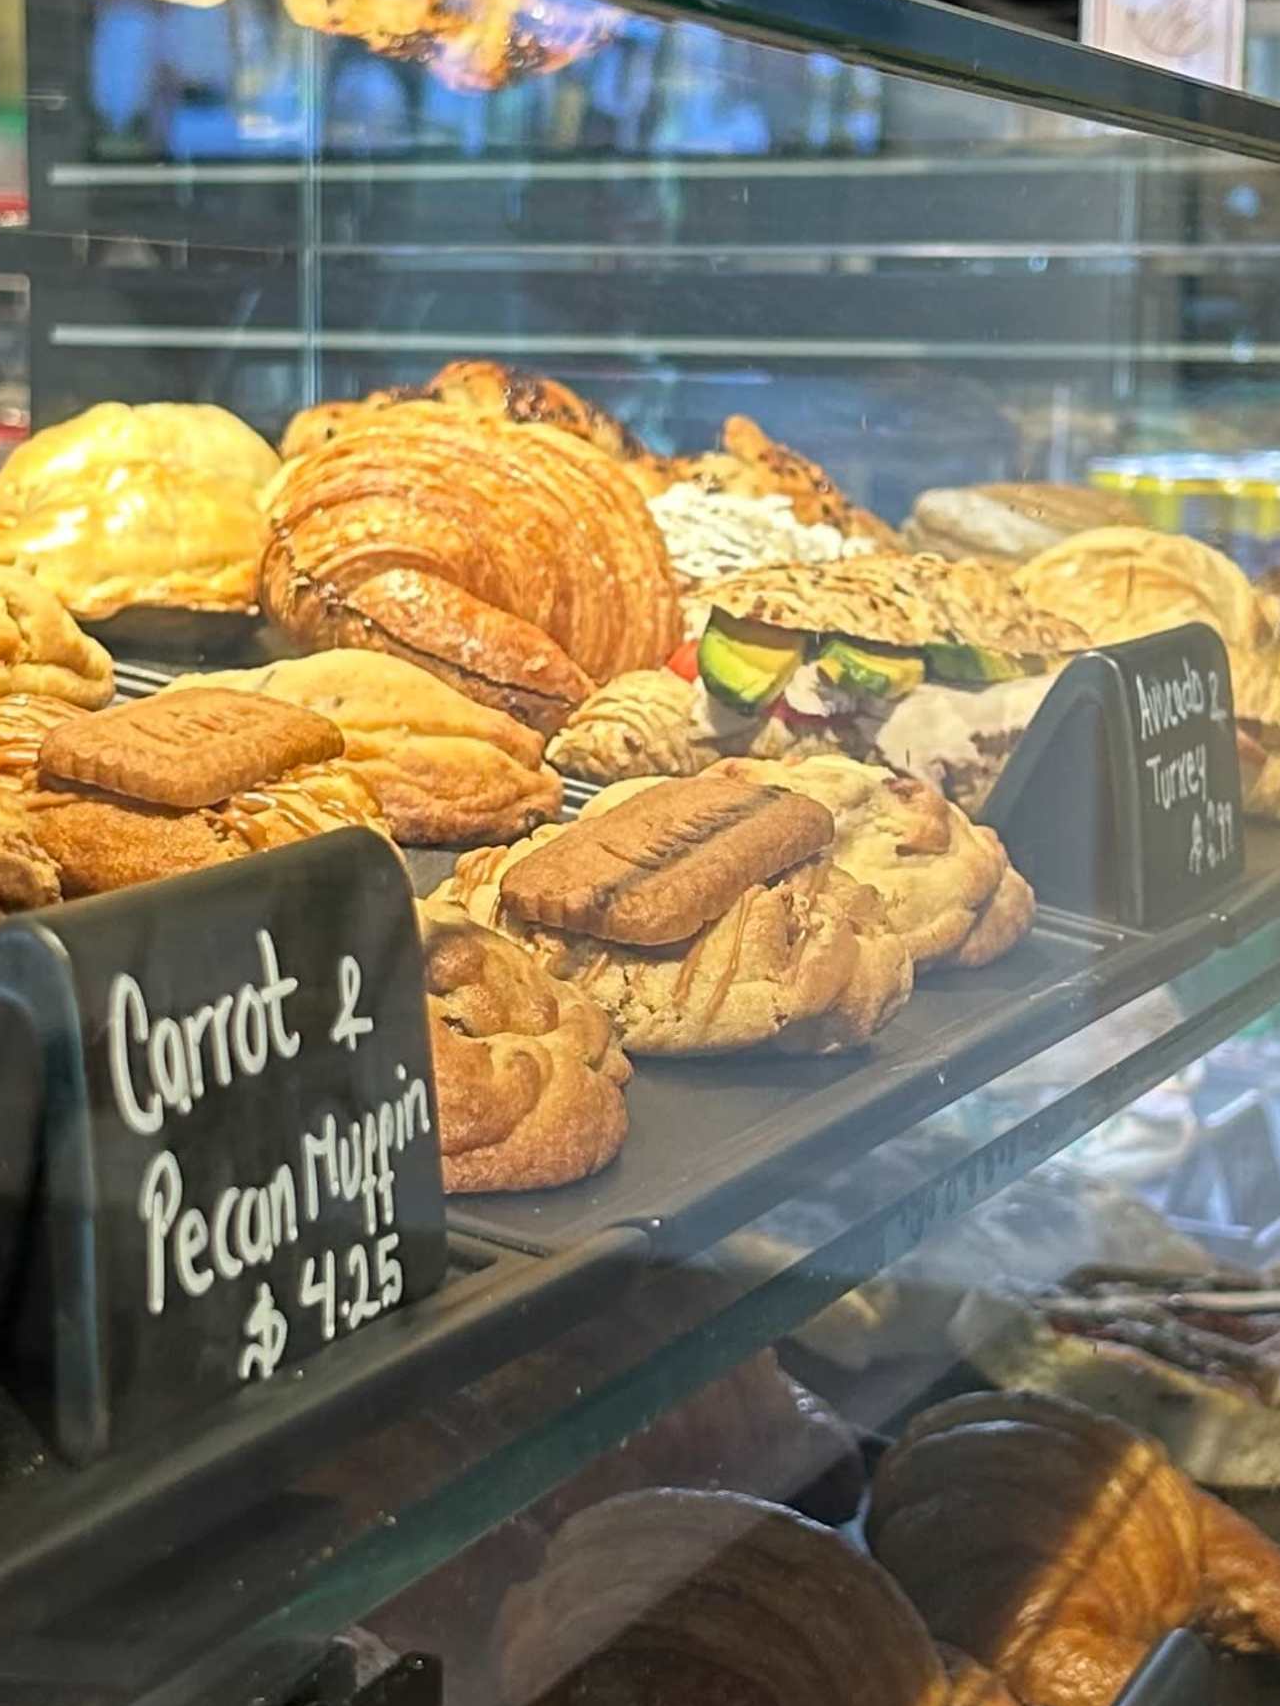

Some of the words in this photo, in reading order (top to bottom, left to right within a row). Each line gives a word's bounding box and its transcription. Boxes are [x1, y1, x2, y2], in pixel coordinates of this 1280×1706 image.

[1145, 743, 1207, 810] Turkey
[107, 929, 302, 1135] Carrot
[137, 1149, 298, 1315] Pecan
[299, 1064, 430, 1236] Muffin
